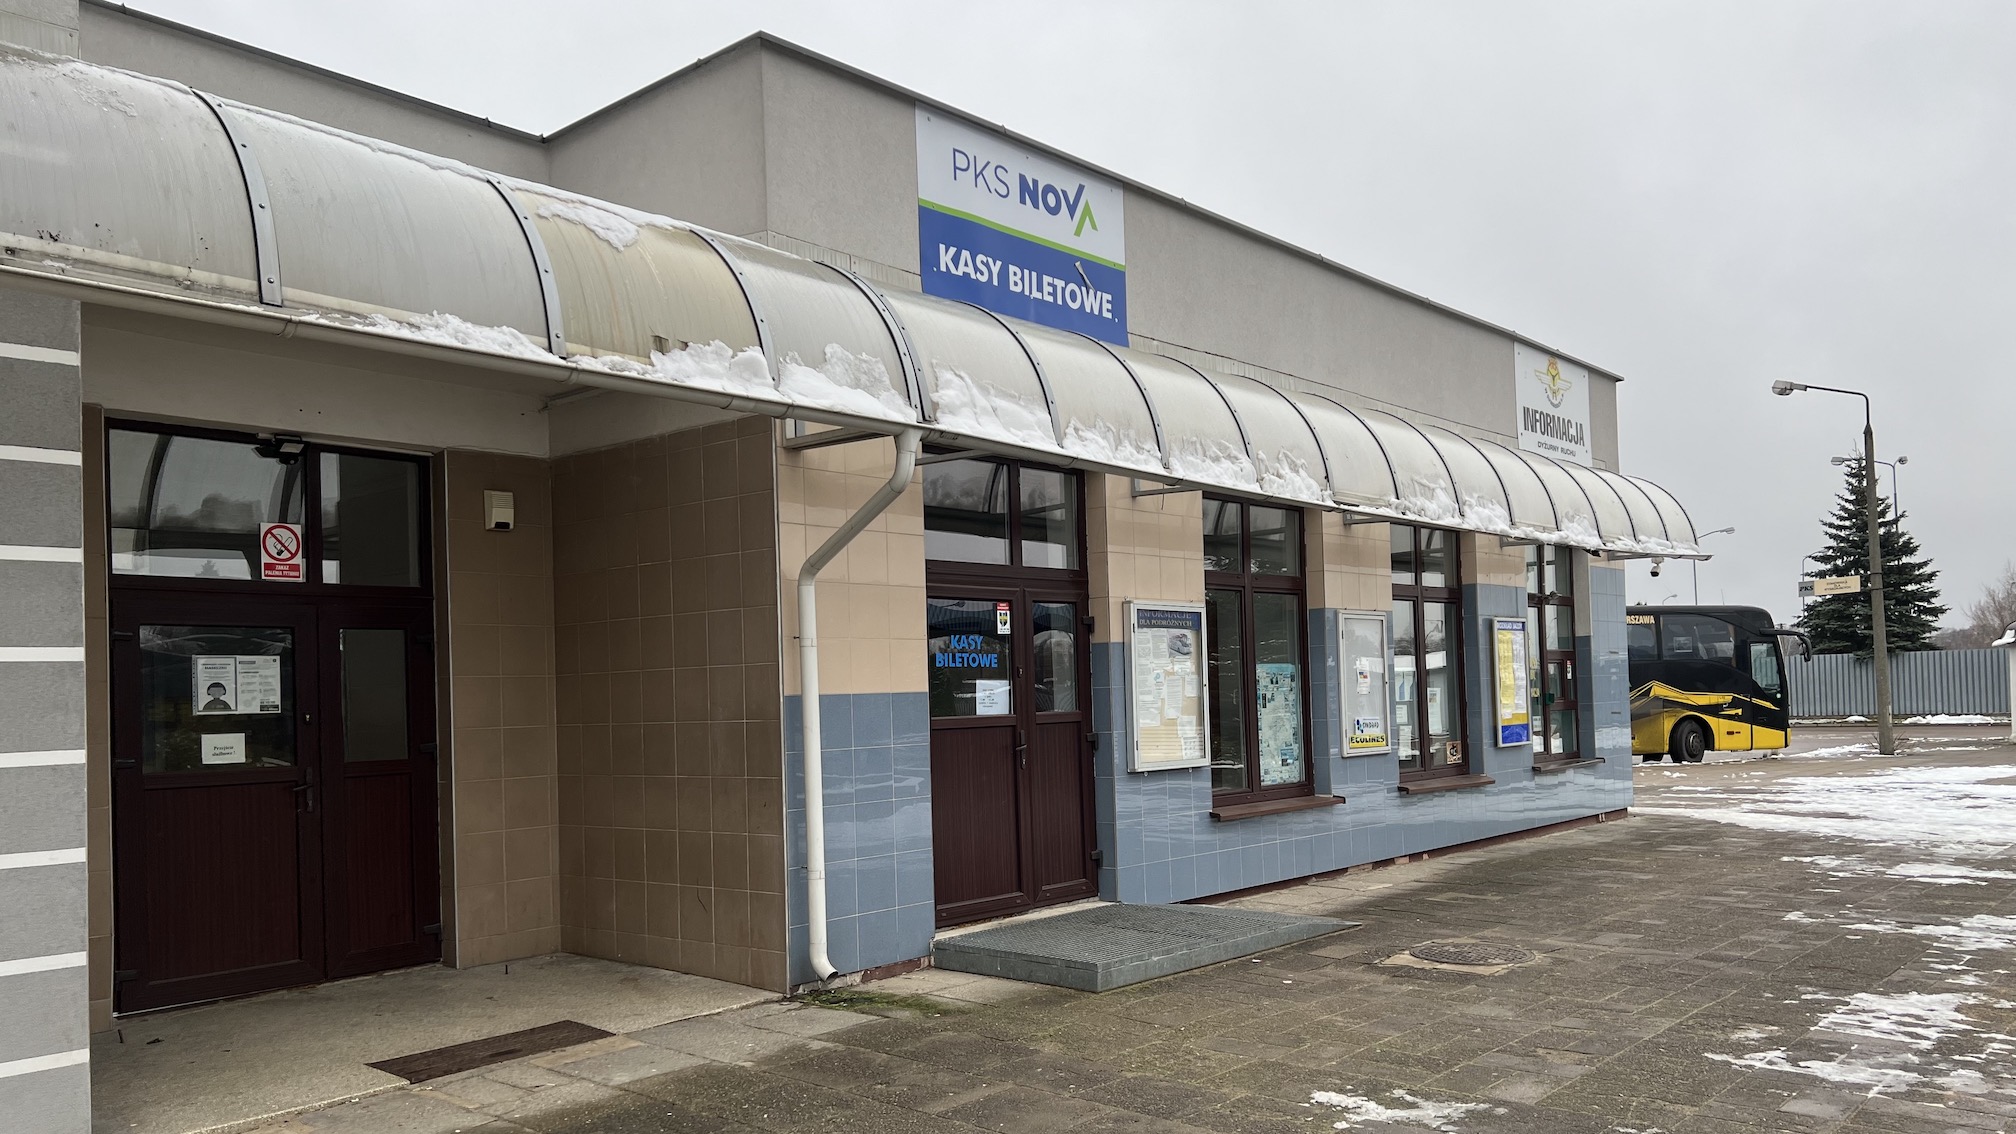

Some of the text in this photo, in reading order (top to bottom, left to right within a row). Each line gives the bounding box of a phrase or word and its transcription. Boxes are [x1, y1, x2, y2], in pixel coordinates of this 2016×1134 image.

[952, 147, 1099, 238] PKS NOVA
[938, 242, 1113, 319] KASY BILETOWE
[1522, 405, 1585, 447] INFORMACJA
[1537, 440, 1577, 457] DYŻURNY RUCHU
[1139, 609, 1192, 619] INFORMACJE
[1151, 618, 1192, 627] PODRÓŻNYCH
[950, 634, 984, 651] KASY
[935, 652, 998, 668] BILETOWE
